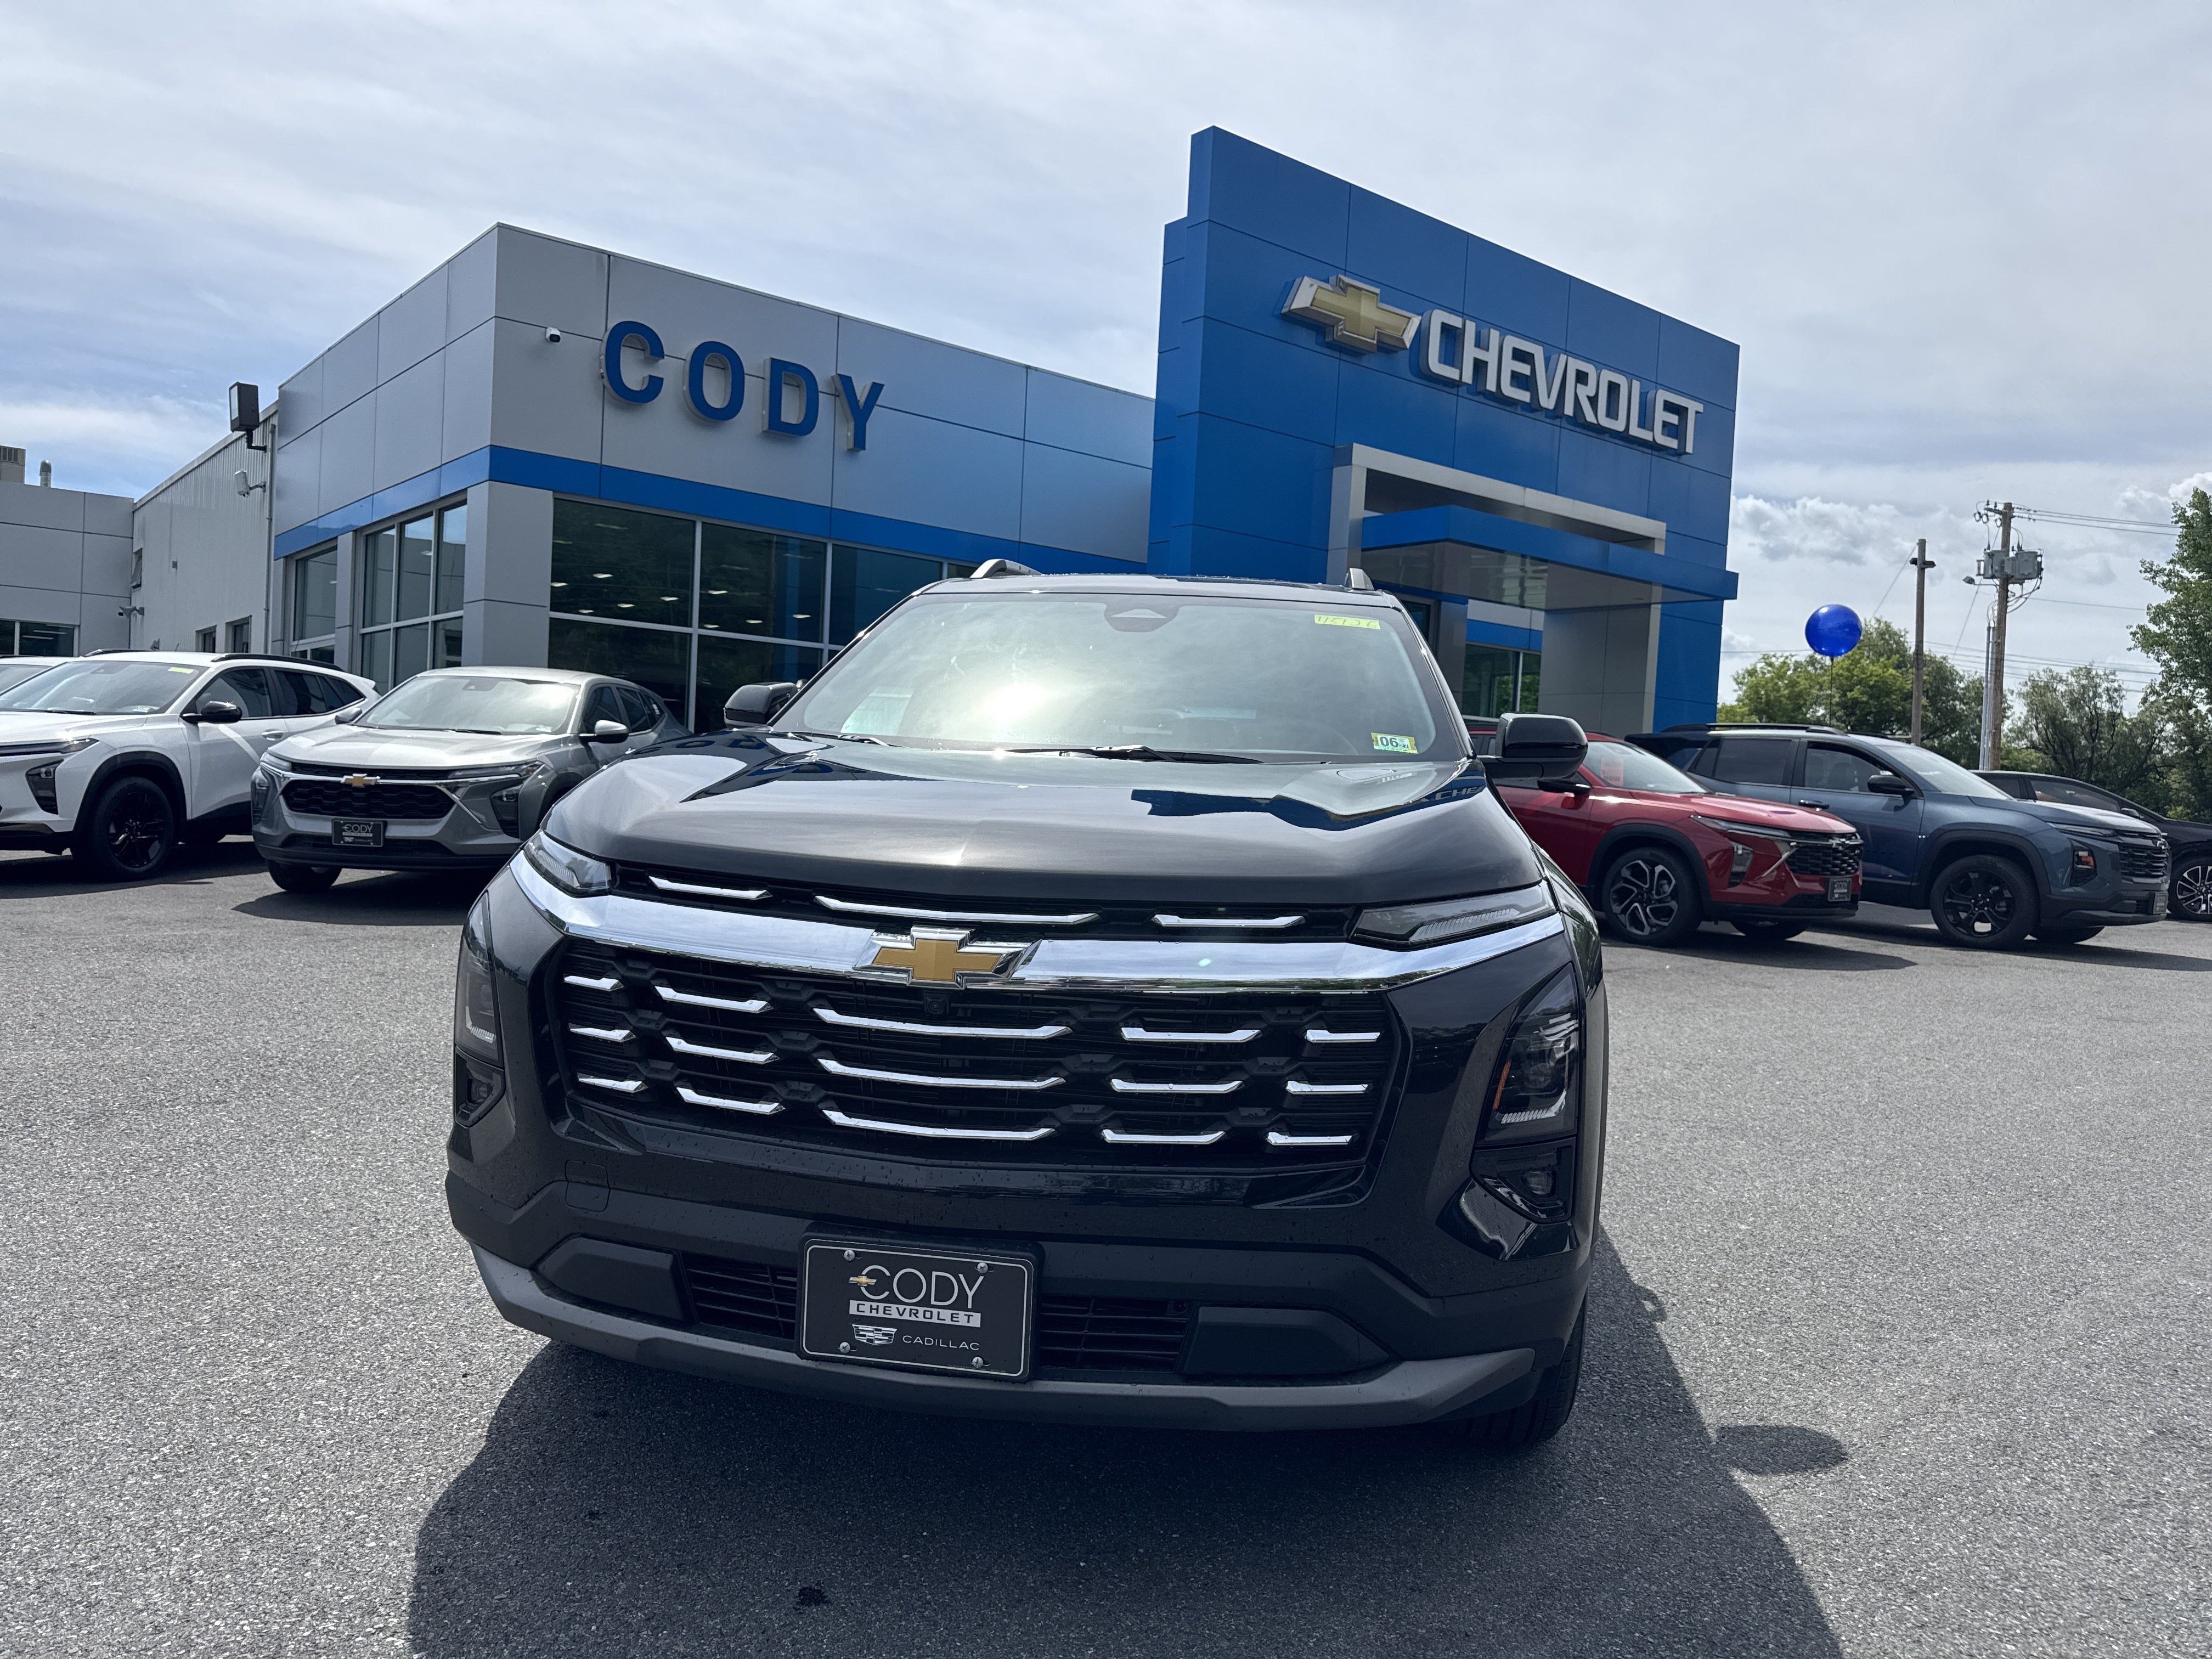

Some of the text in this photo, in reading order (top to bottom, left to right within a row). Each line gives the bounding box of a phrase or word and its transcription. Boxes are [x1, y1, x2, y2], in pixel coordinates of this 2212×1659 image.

[601, 321, 884, 451] CODY
[1421, 309, 1703, 454] CHEVROLET
[1380, 736, 1399, 747] 06
[345, 824, 373, 833] CODY
[860, 1265, 984, 1308] CODY
[856, 1304, 974, 1324] CHEVROLET
[902, 1335, 980, 1351] CADILLAC
